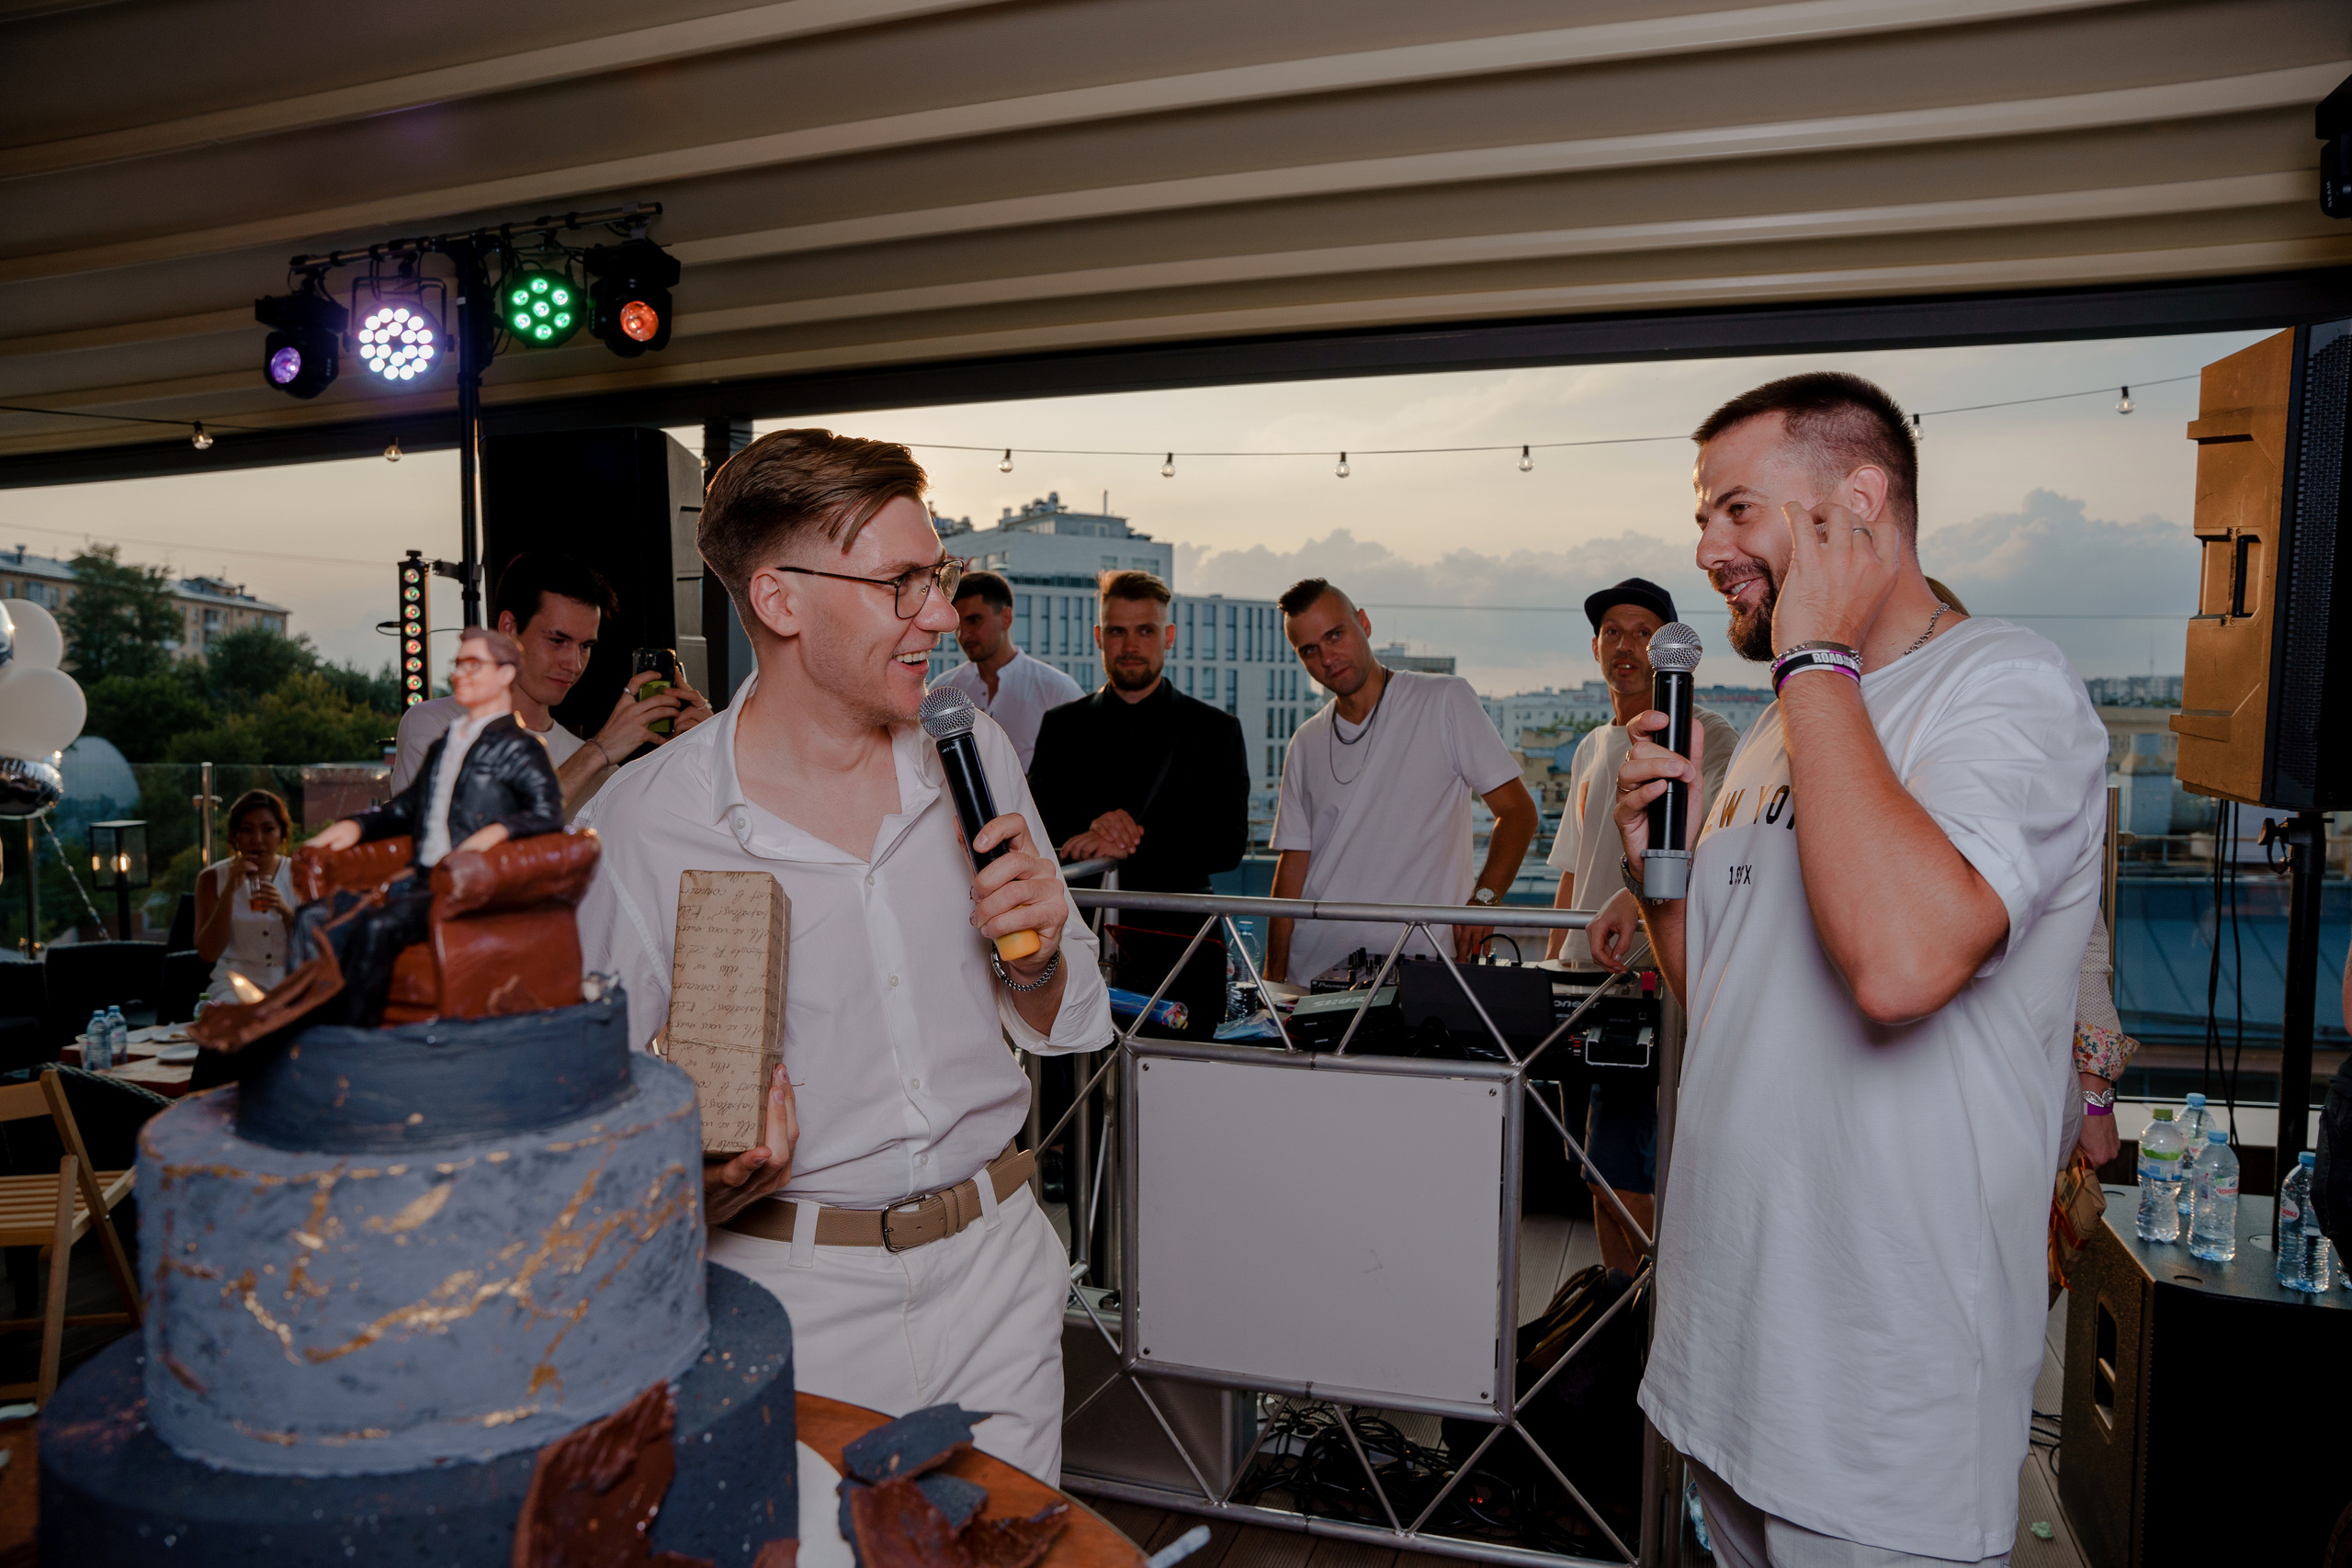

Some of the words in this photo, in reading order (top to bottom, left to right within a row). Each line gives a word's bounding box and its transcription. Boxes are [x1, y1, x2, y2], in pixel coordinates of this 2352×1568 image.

[1812, 652, 1844, 665] ROAD
[1702, 788, 1746, 836] EW
[1753, 784, 1795, 830] YO
[1554, 999, 1600, 1010] oner
